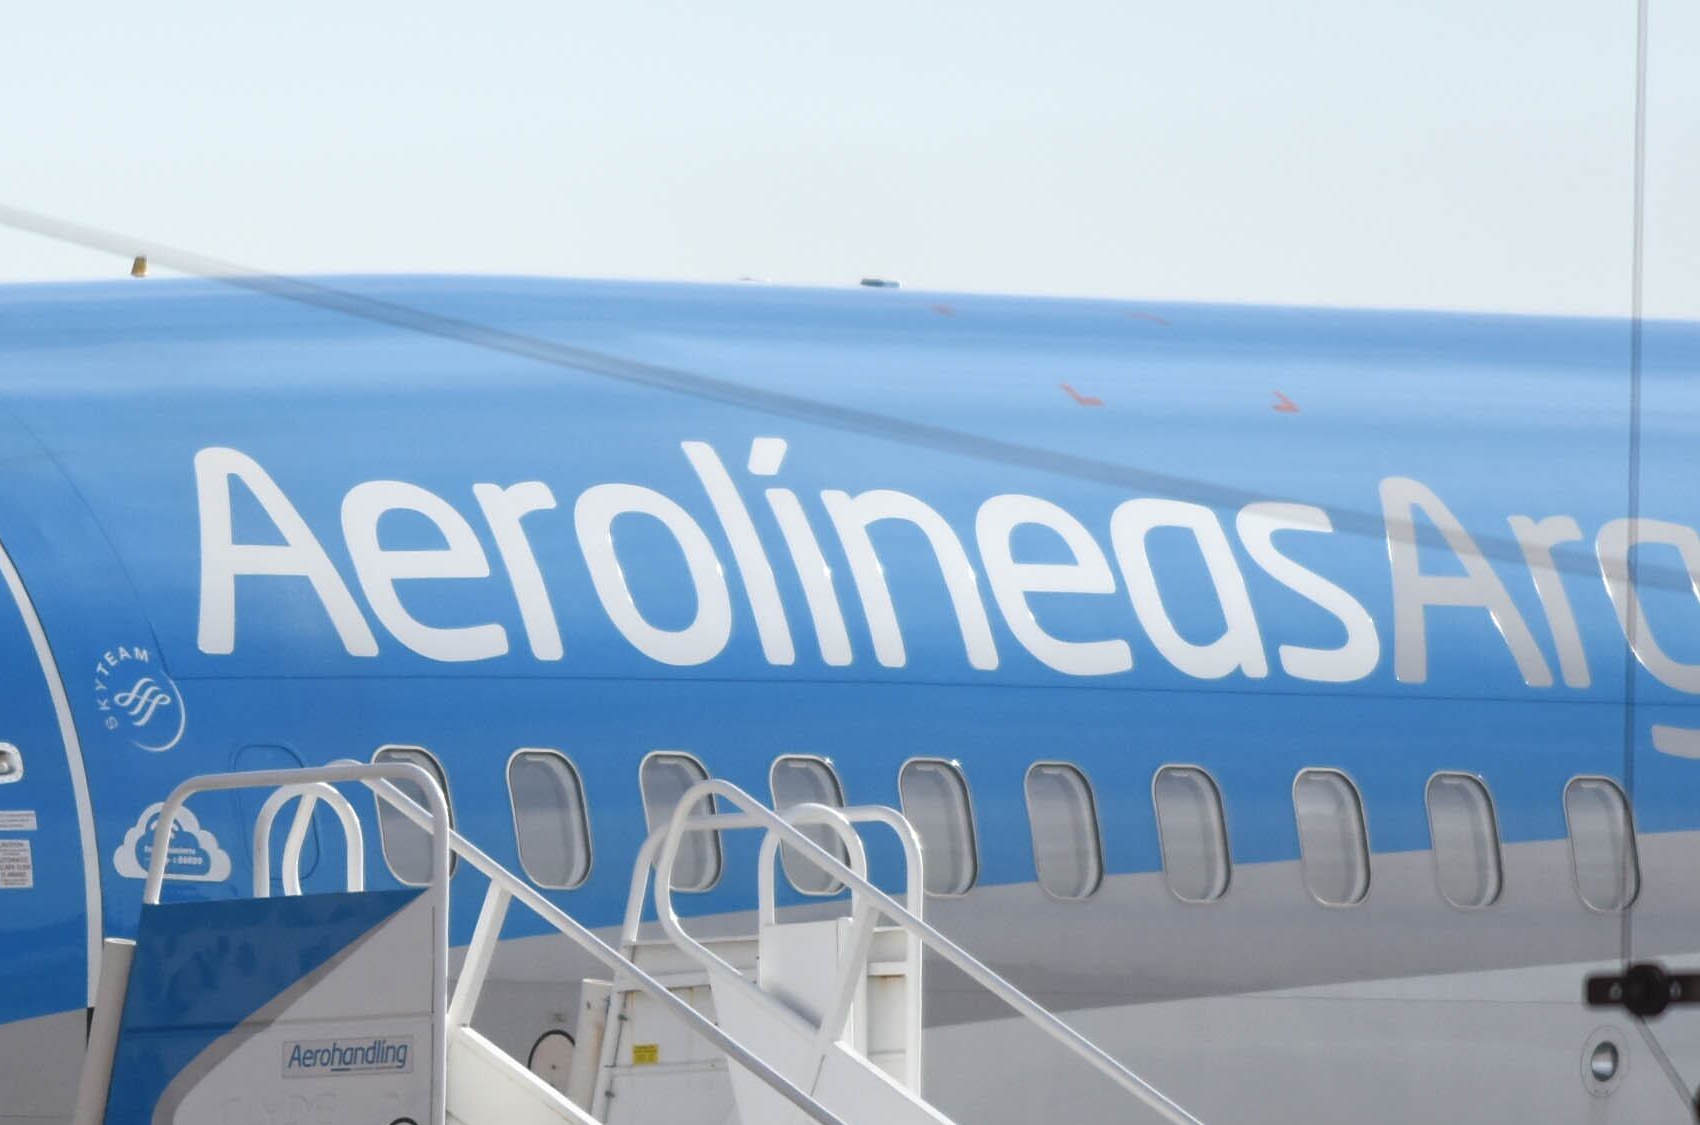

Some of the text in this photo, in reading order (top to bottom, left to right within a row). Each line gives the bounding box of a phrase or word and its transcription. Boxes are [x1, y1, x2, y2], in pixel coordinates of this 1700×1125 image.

[194, 437, 1380, 683] Aerolíneas
[94, 645, 150, 731] SKYTEAM
[288, 1039, 408, 1069] Aerohandling
